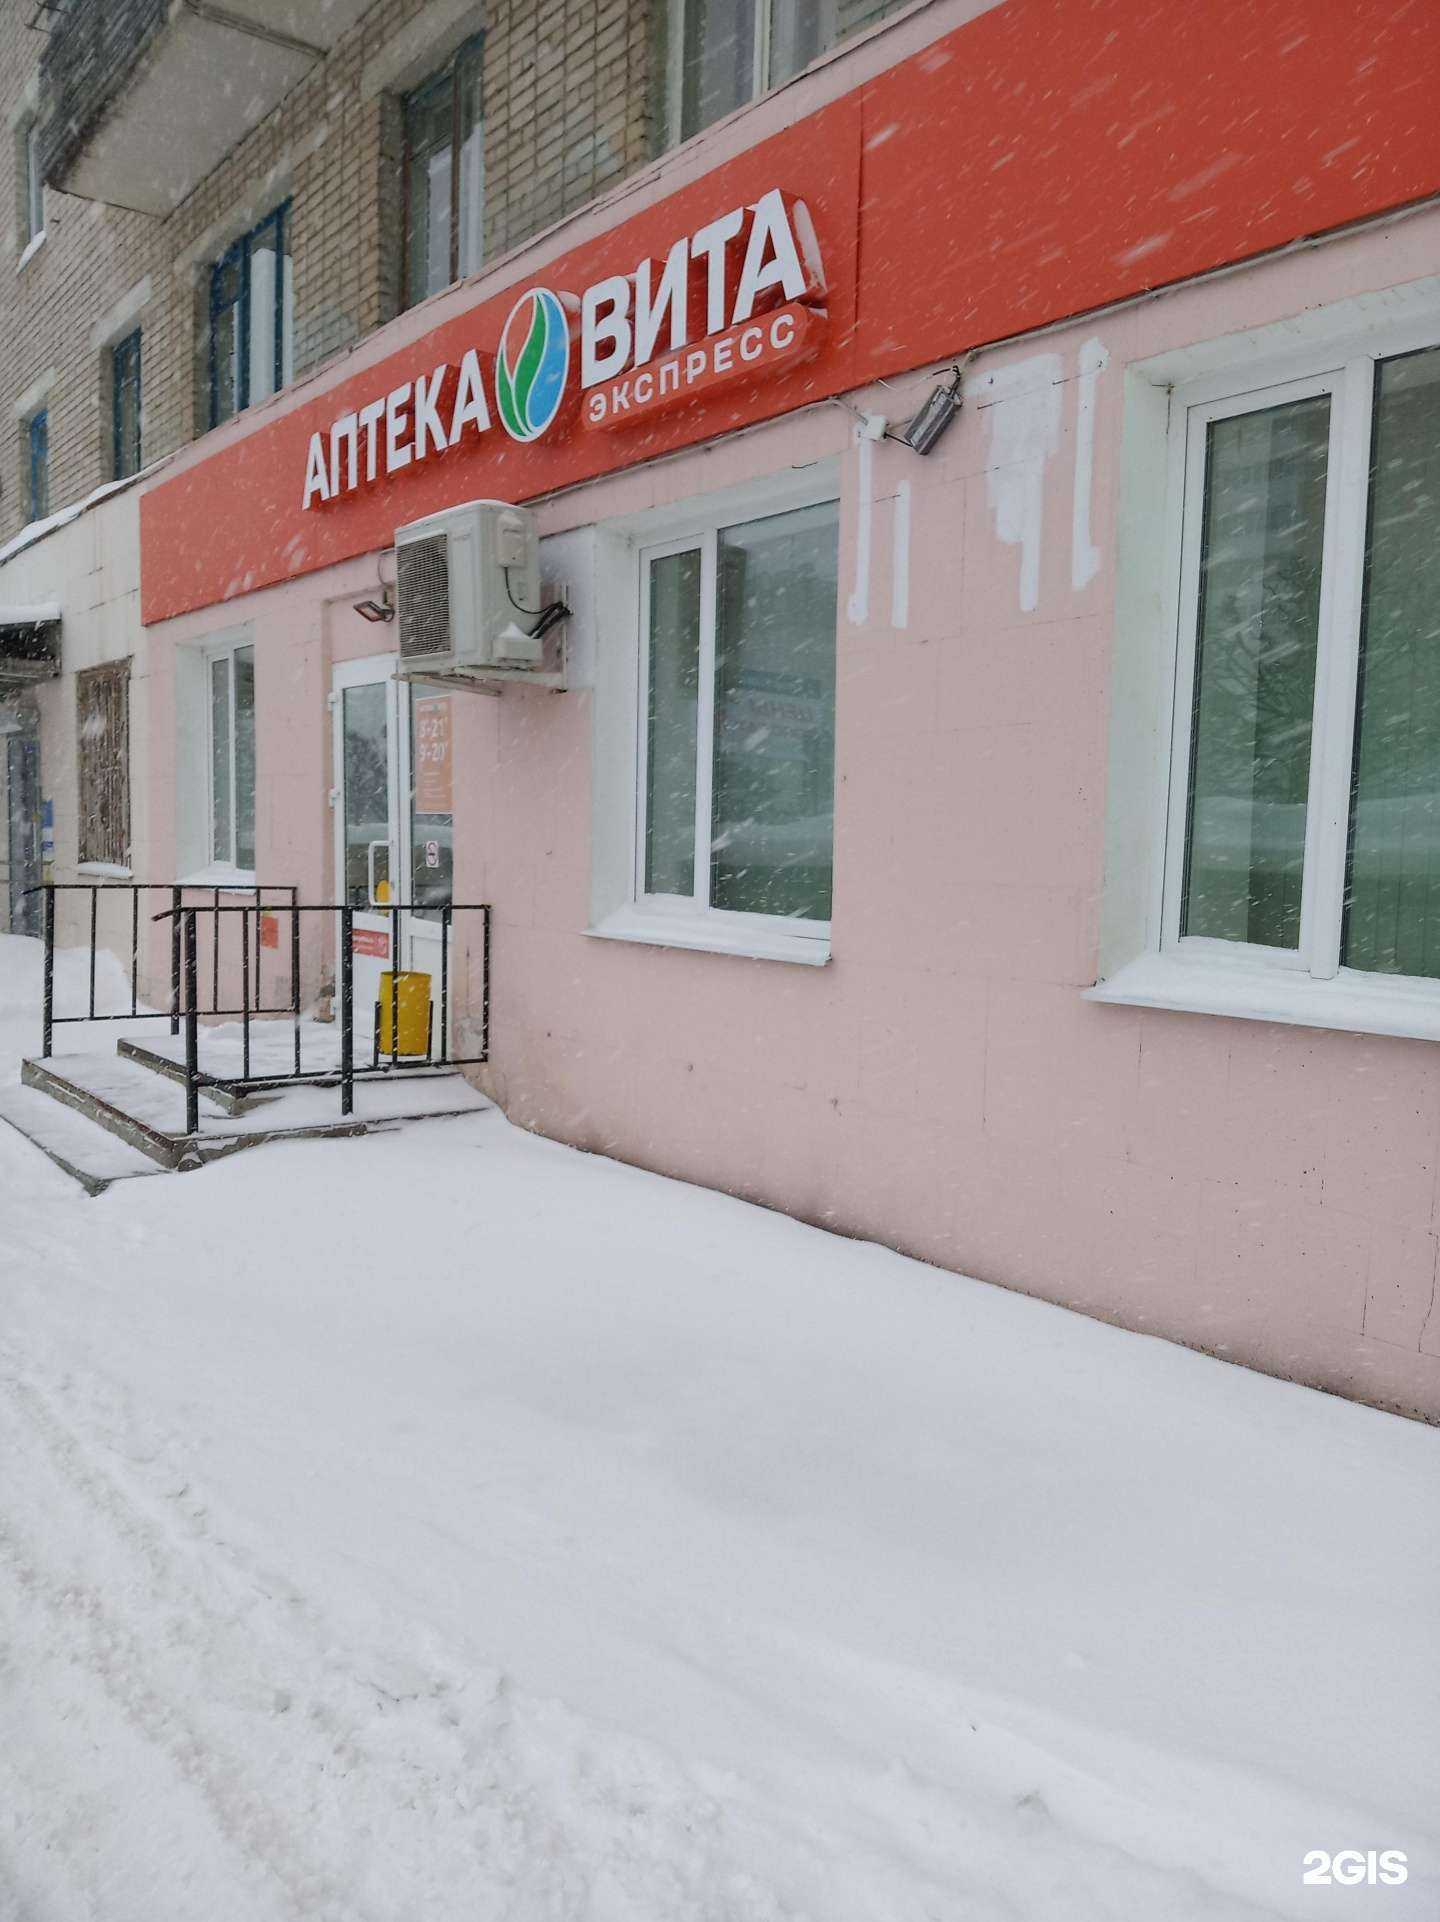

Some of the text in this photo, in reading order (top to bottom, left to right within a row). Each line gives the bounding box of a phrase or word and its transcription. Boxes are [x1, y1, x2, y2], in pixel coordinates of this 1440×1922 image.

[302, 188, 807, 511] АПТЕКА ВИТА
[588, 313, 796, 423] ЭКСПРЕСС
